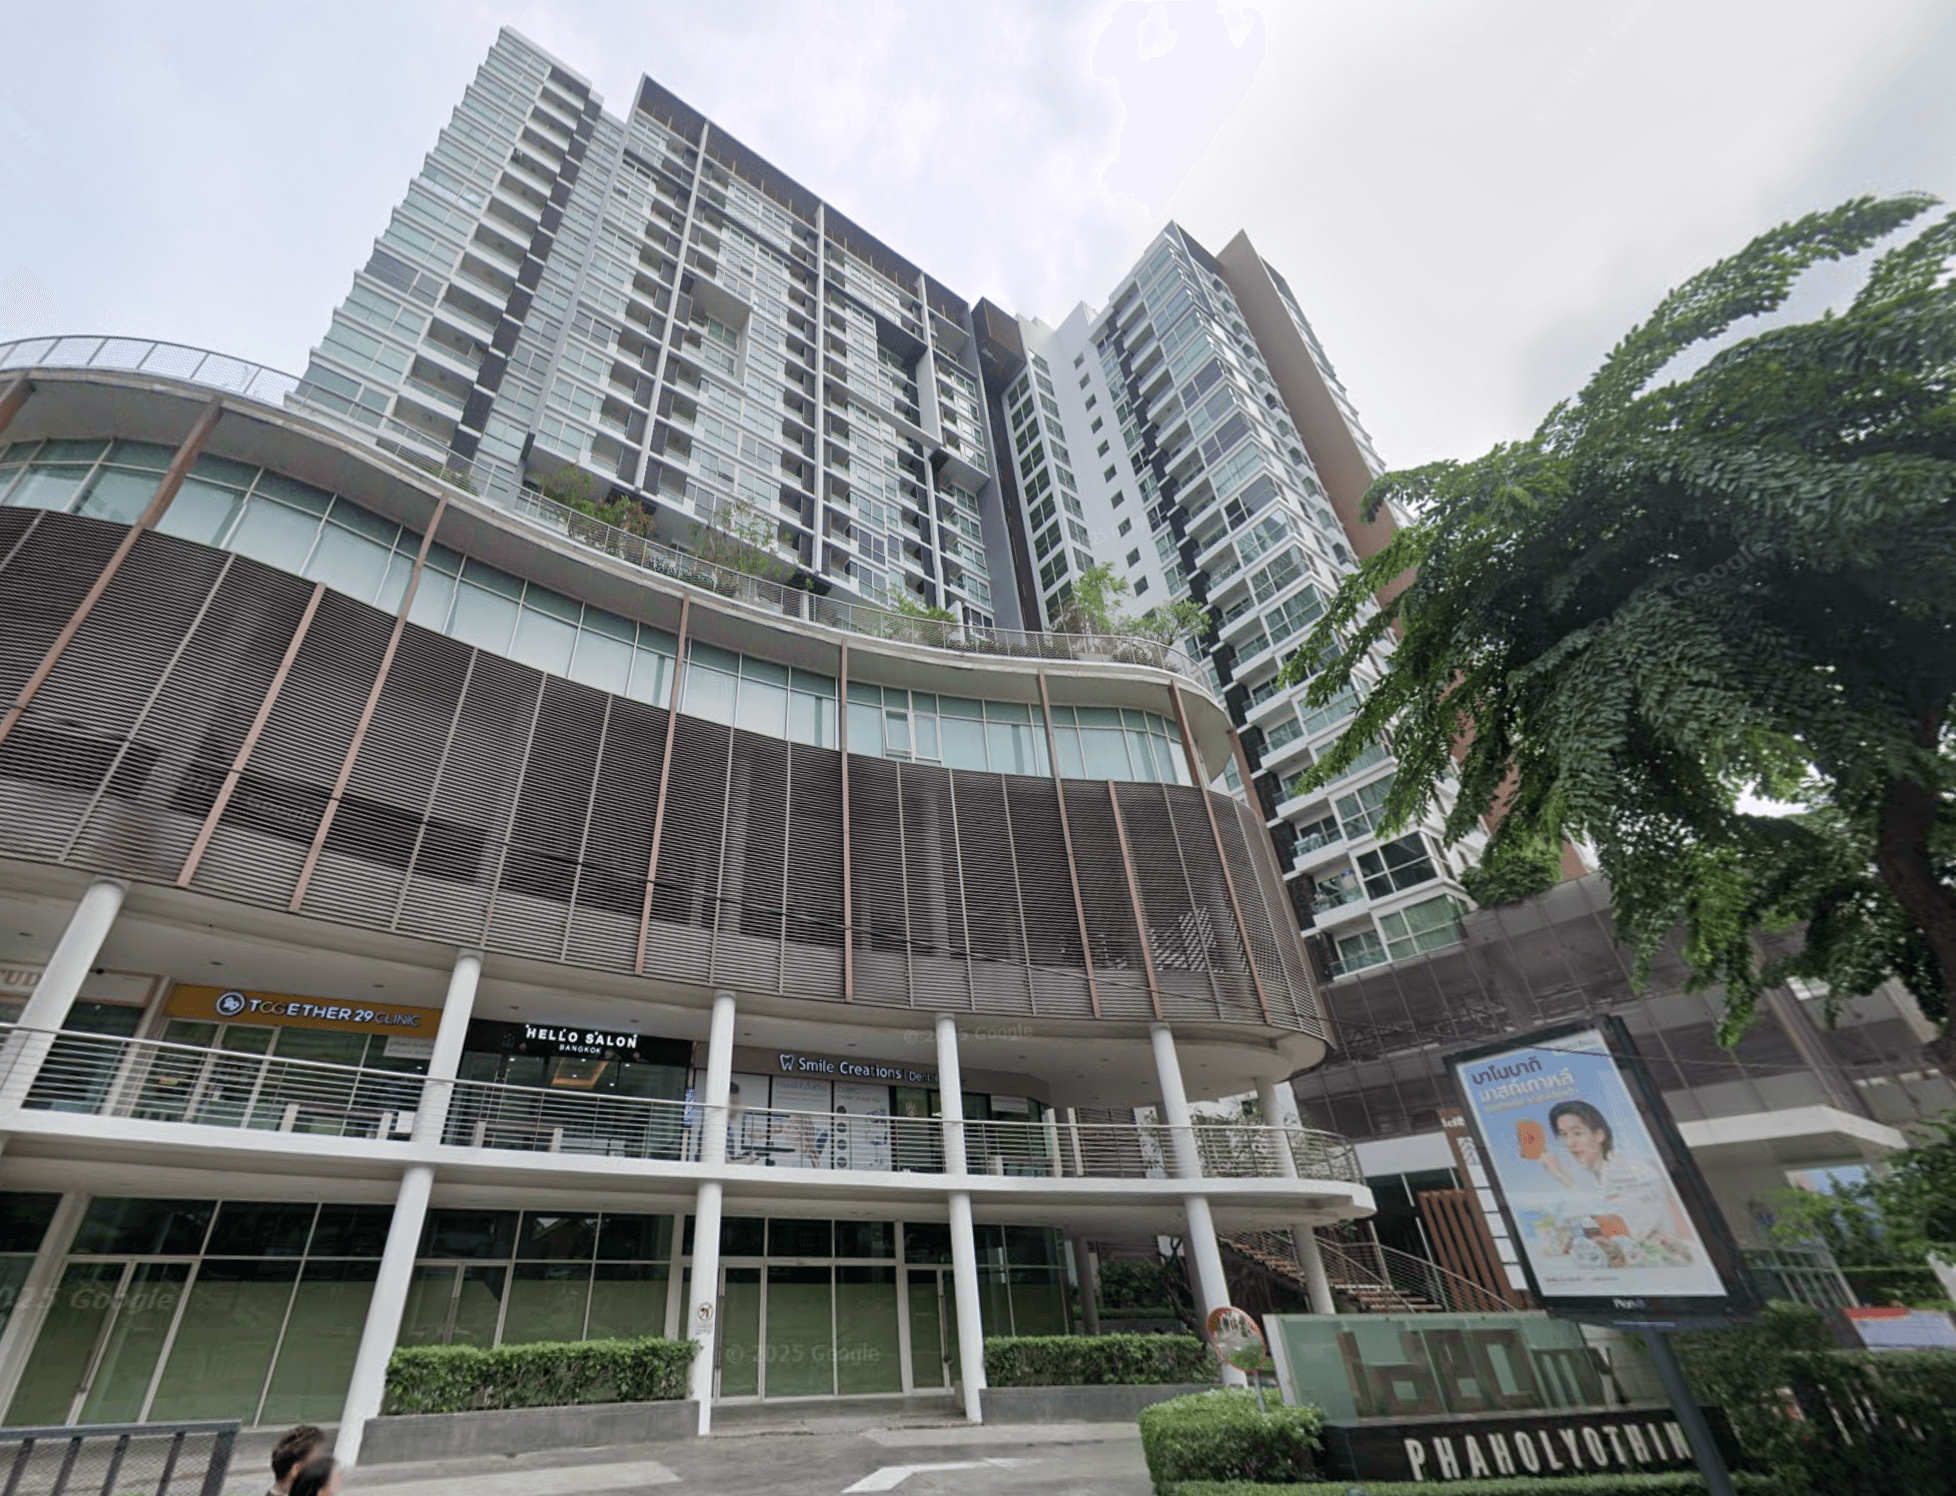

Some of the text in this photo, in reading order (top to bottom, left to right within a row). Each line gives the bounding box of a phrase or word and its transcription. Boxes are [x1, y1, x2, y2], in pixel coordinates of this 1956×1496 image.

[354, 1009, 375, 1022] 29
[526, 1025, 638, 1049] HELLO SALON
[559, 1043, 602, 1054] BANGKOK
[798, 1057, 835, 1073] Smile
[840, 1061, 902, 1080] Creations
[1403, 1421, 1693, 1481] PHAHOLYOTHIN
